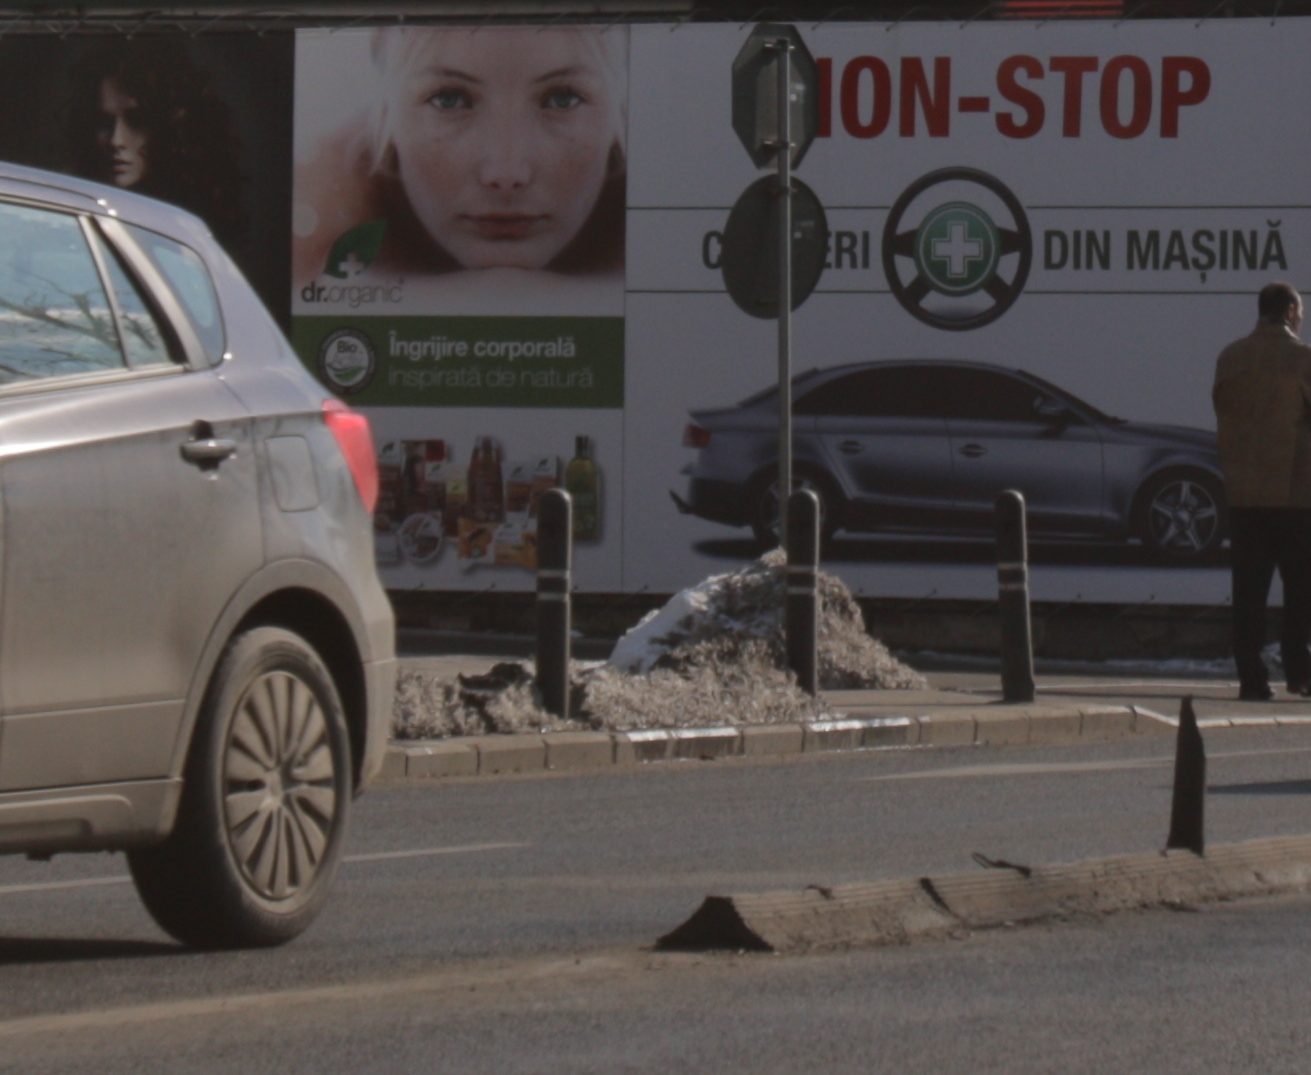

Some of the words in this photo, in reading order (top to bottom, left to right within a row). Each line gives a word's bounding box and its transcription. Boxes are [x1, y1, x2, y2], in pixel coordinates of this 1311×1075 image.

[1043, 229, 1111, 271] DIN
[1126, 218, 1289, 284] MAȘINĂ
[388, 330, 469, 361] Îngrijire
[473, 335, 576, 362] corporală
[485, 366, 516, 388] de
[520, 366, 594, 389] natură
